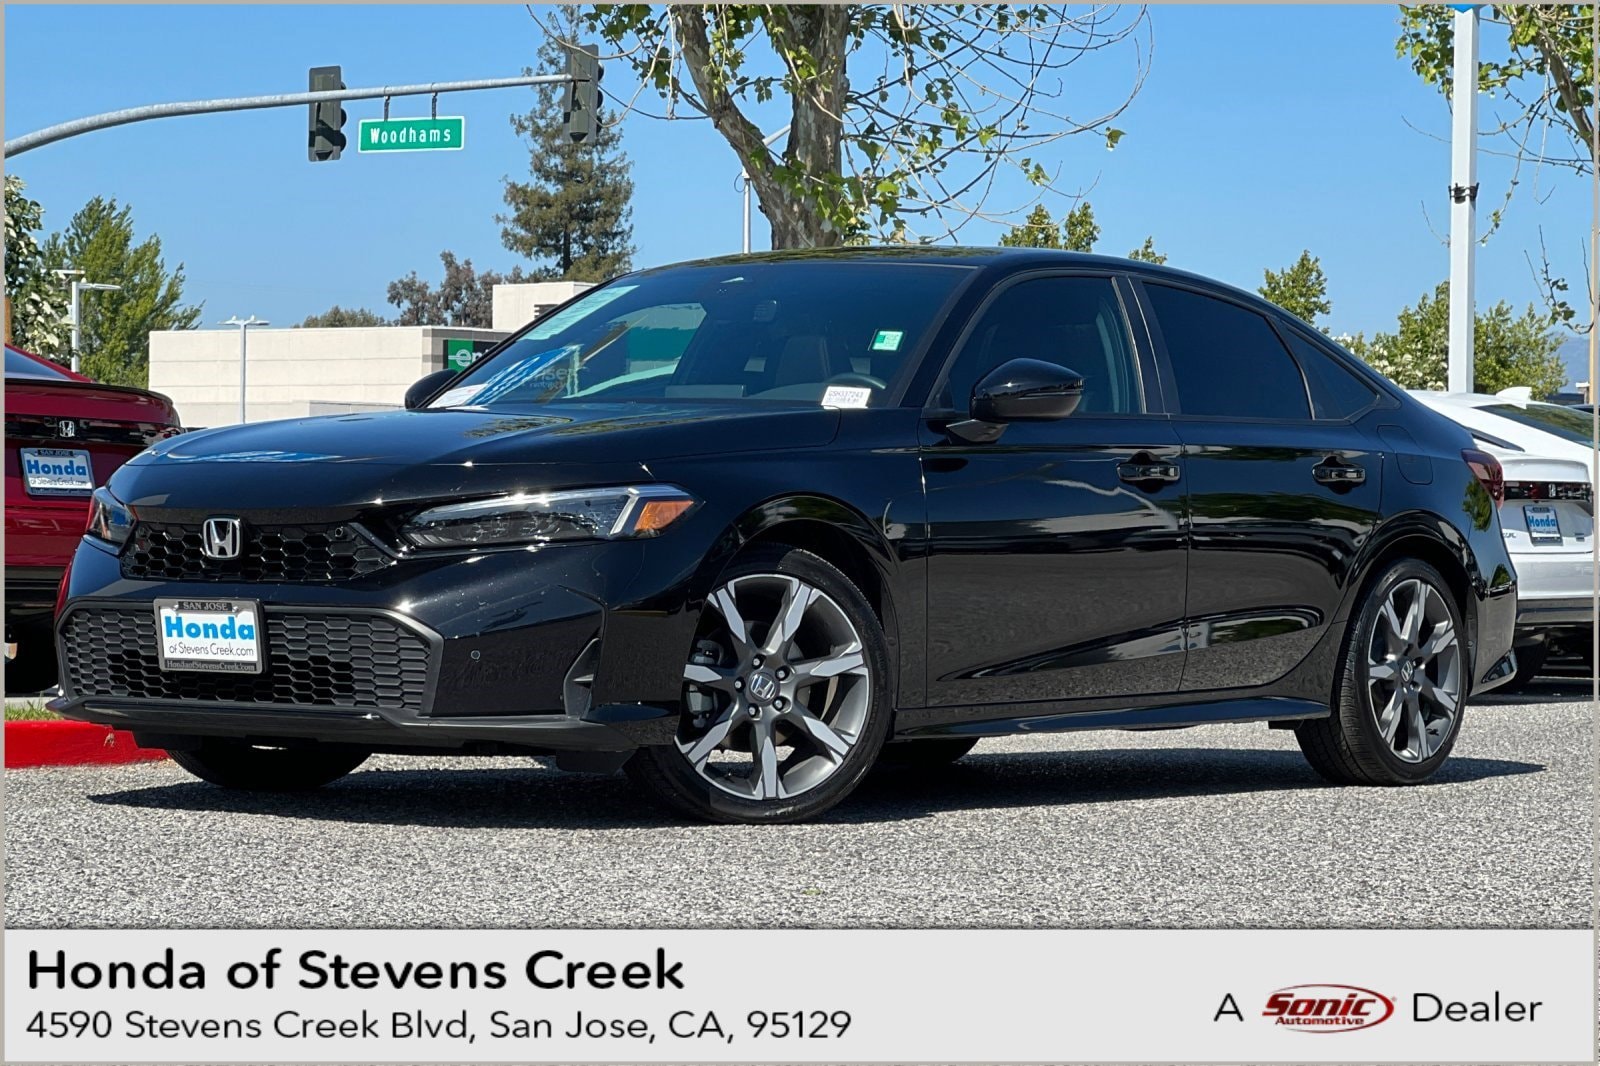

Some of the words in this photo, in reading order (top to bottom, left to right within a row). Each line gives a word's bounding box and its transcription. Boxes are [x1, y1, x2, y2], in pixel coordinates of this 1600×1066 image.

[370, 126, 451, 144] Woodhams
[26, 460, 86, 475] Honda
[1528, 515, 1556, 527] Honda
[183, 602, 202, 610] SAN
[204, 602, 229, 611] JOSE
[165, 615, 255, 640] Honda
[169, 645, 177, 654] of
